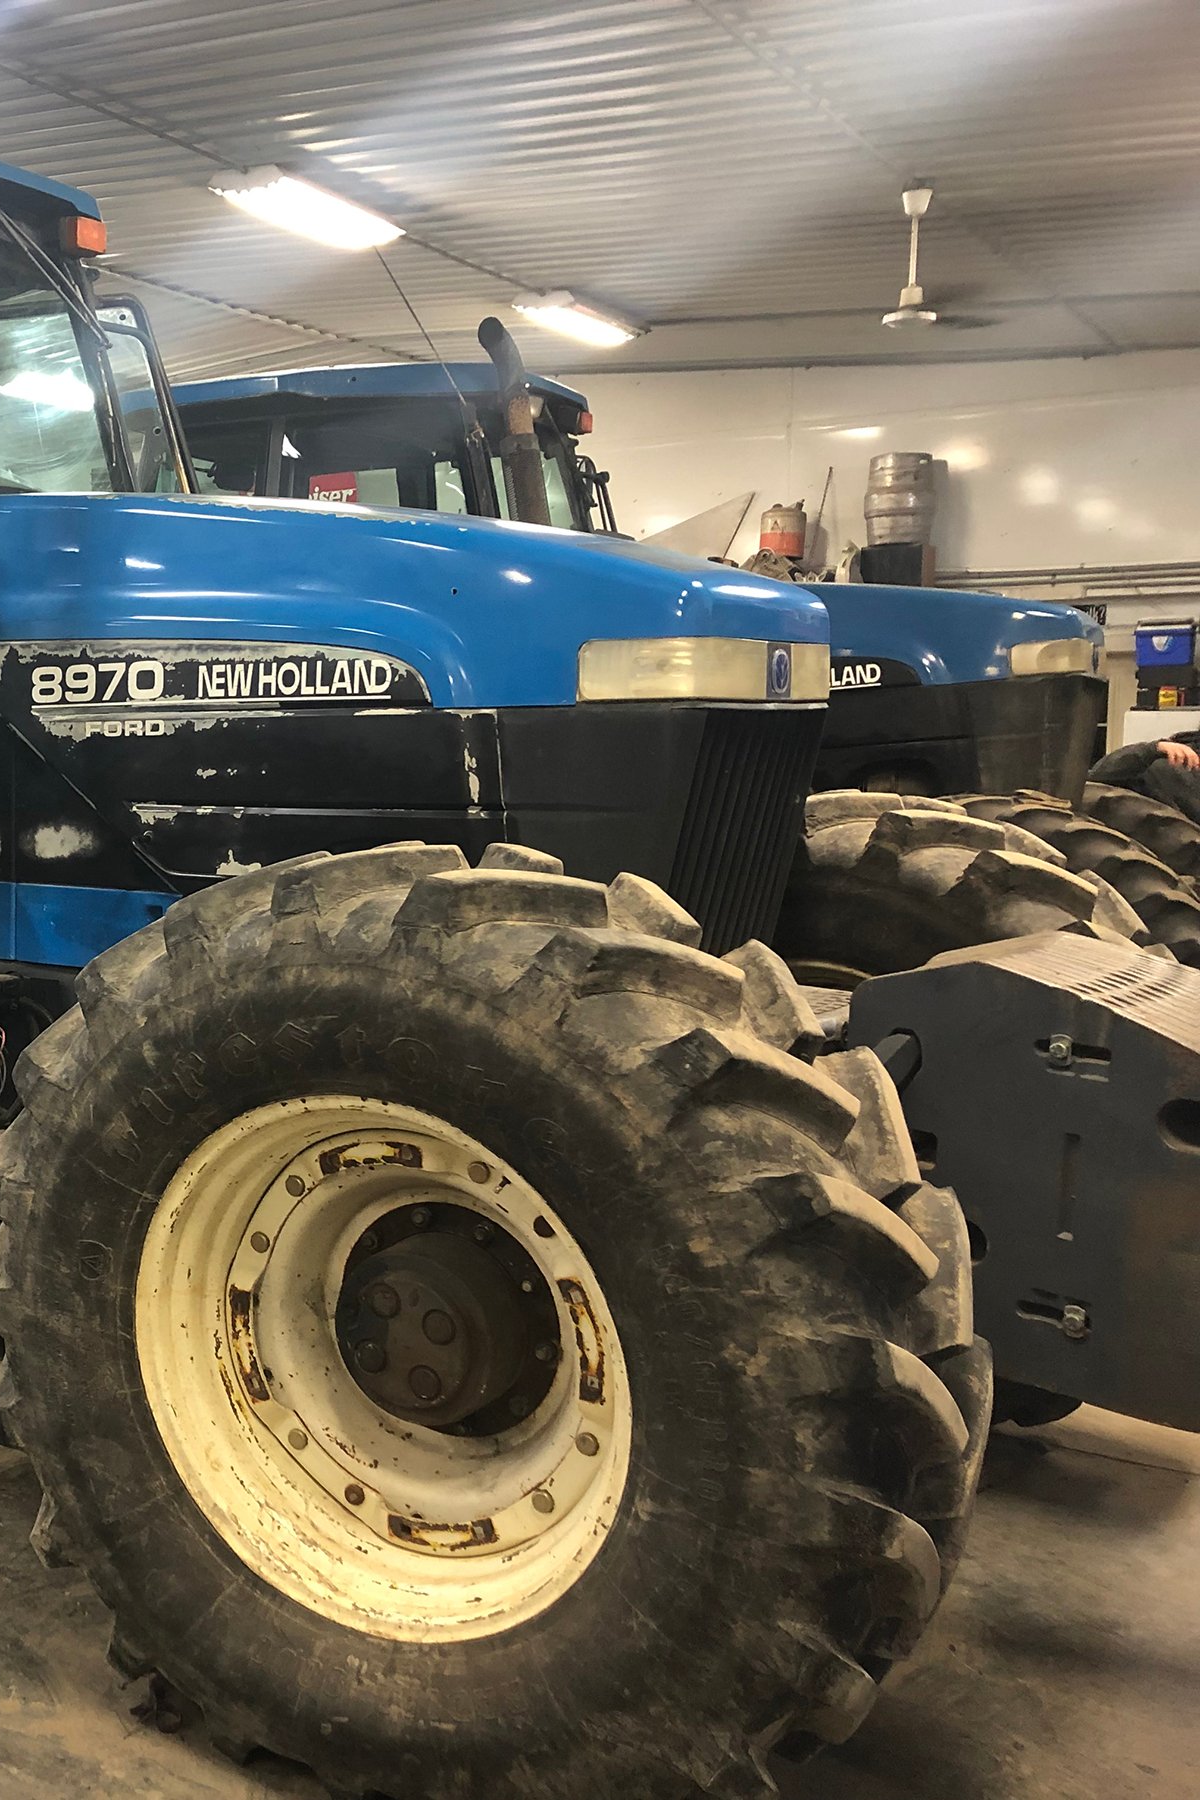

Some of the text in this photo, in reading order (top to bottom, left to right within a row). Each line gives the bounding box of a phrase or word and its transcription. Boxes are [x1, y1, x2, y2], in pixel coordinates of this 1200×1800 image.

[308, 486, 357, 503] iser
[31, 659, 392, 704] 8970 NEW HOLLAND
[830, 663, 882, 687] LAND
[85, 719, 165, 738] FORD
